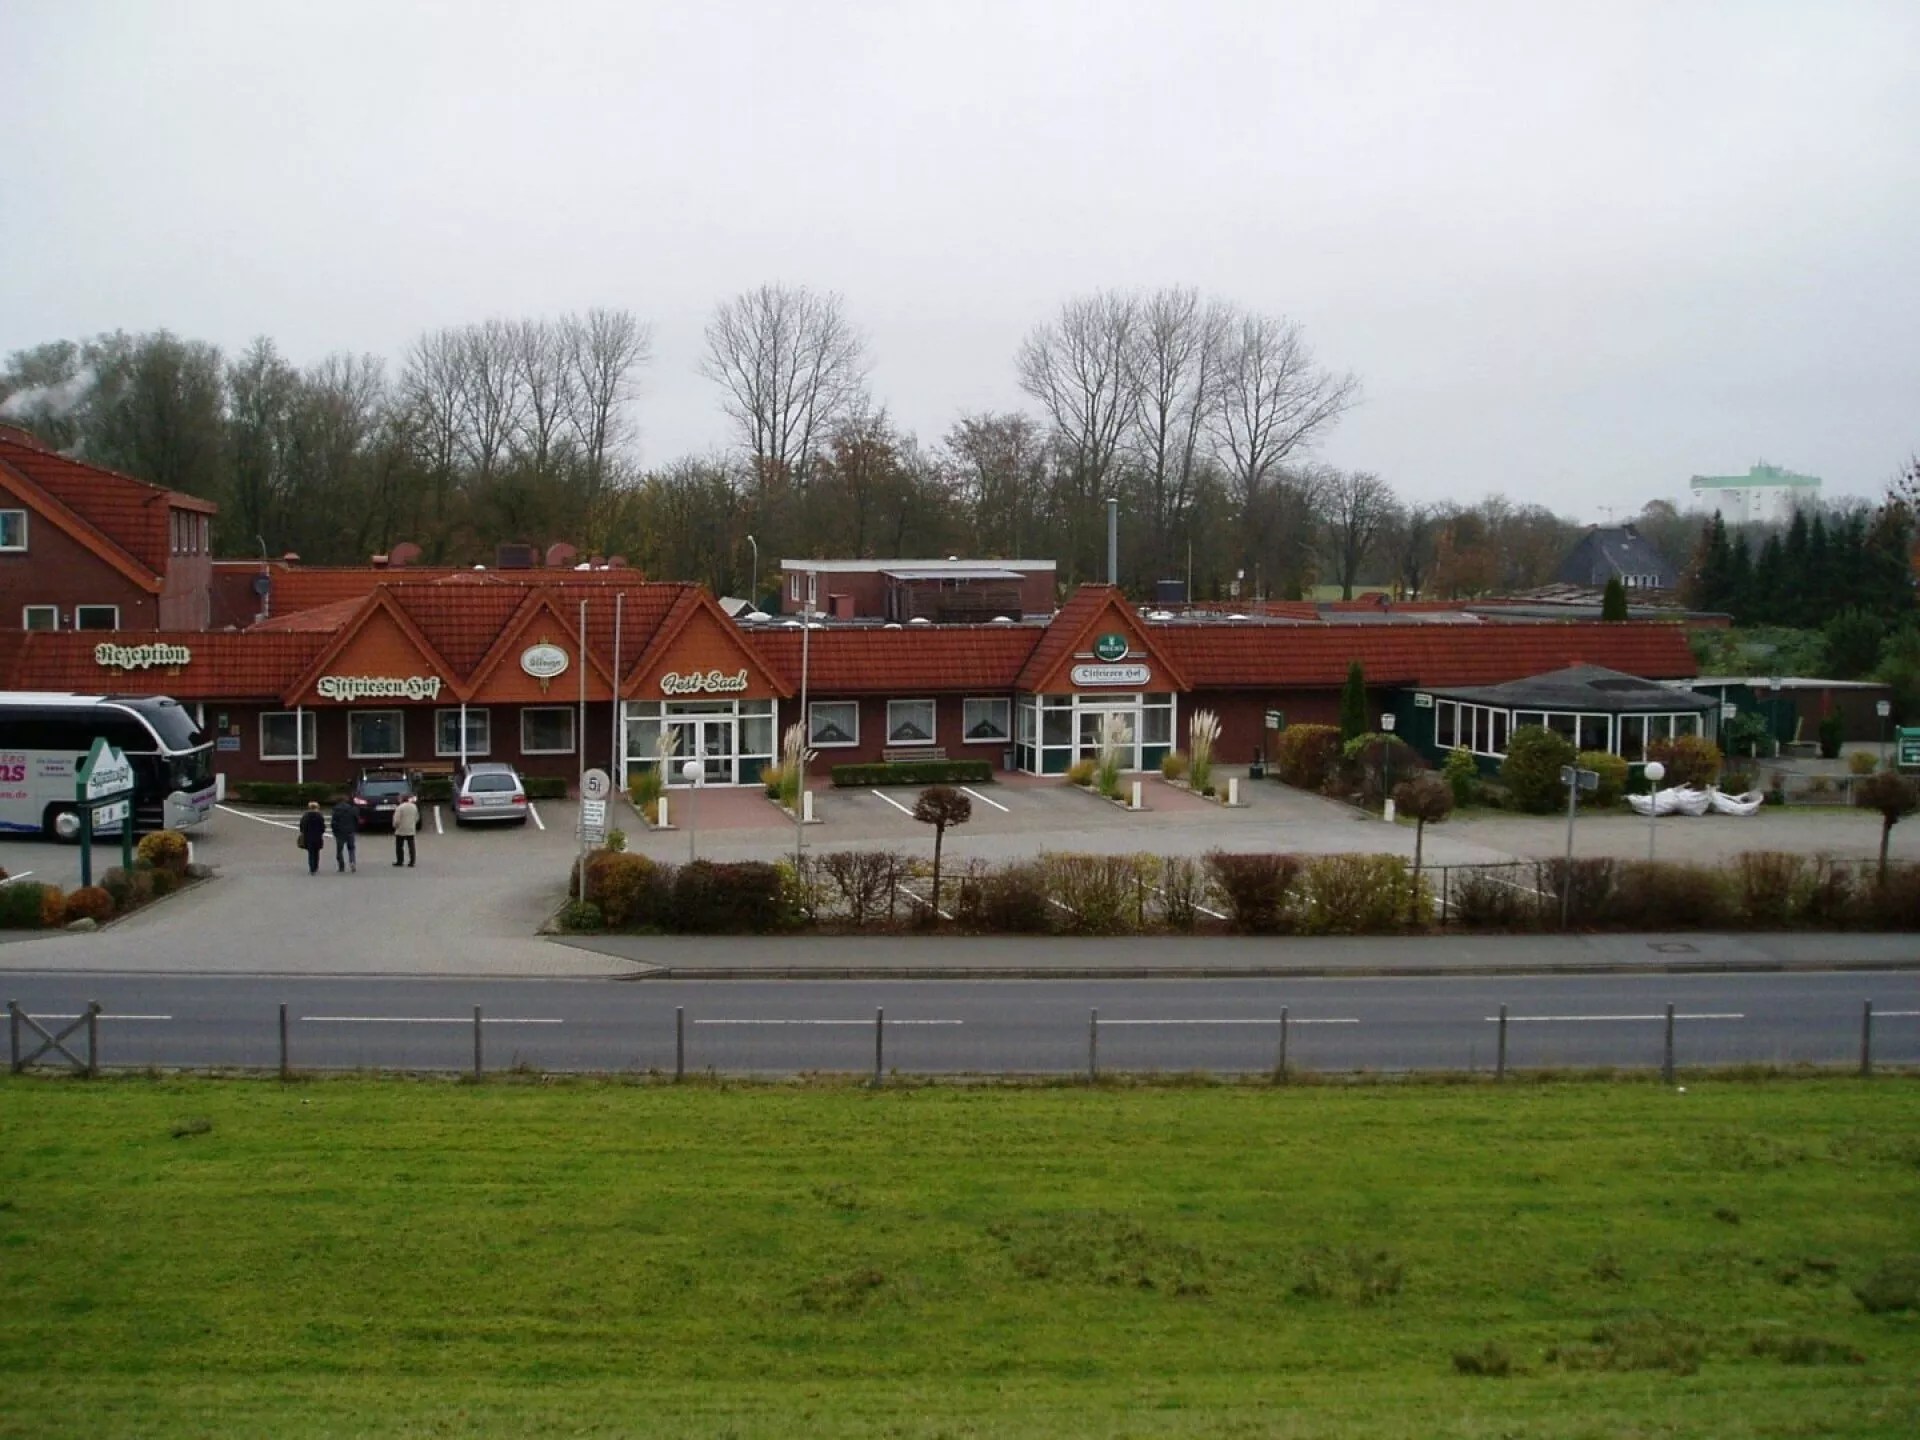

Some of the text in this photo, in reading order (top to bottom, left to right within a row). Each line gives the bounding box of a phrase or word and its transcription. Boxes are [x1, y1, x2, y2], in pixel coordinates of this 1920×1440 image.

[96, 644, 189, 668] Rezeption
[319, 677, 439, 699] Ostfriesen Hof
[661, 670, 747, 694] Fest-Saal
